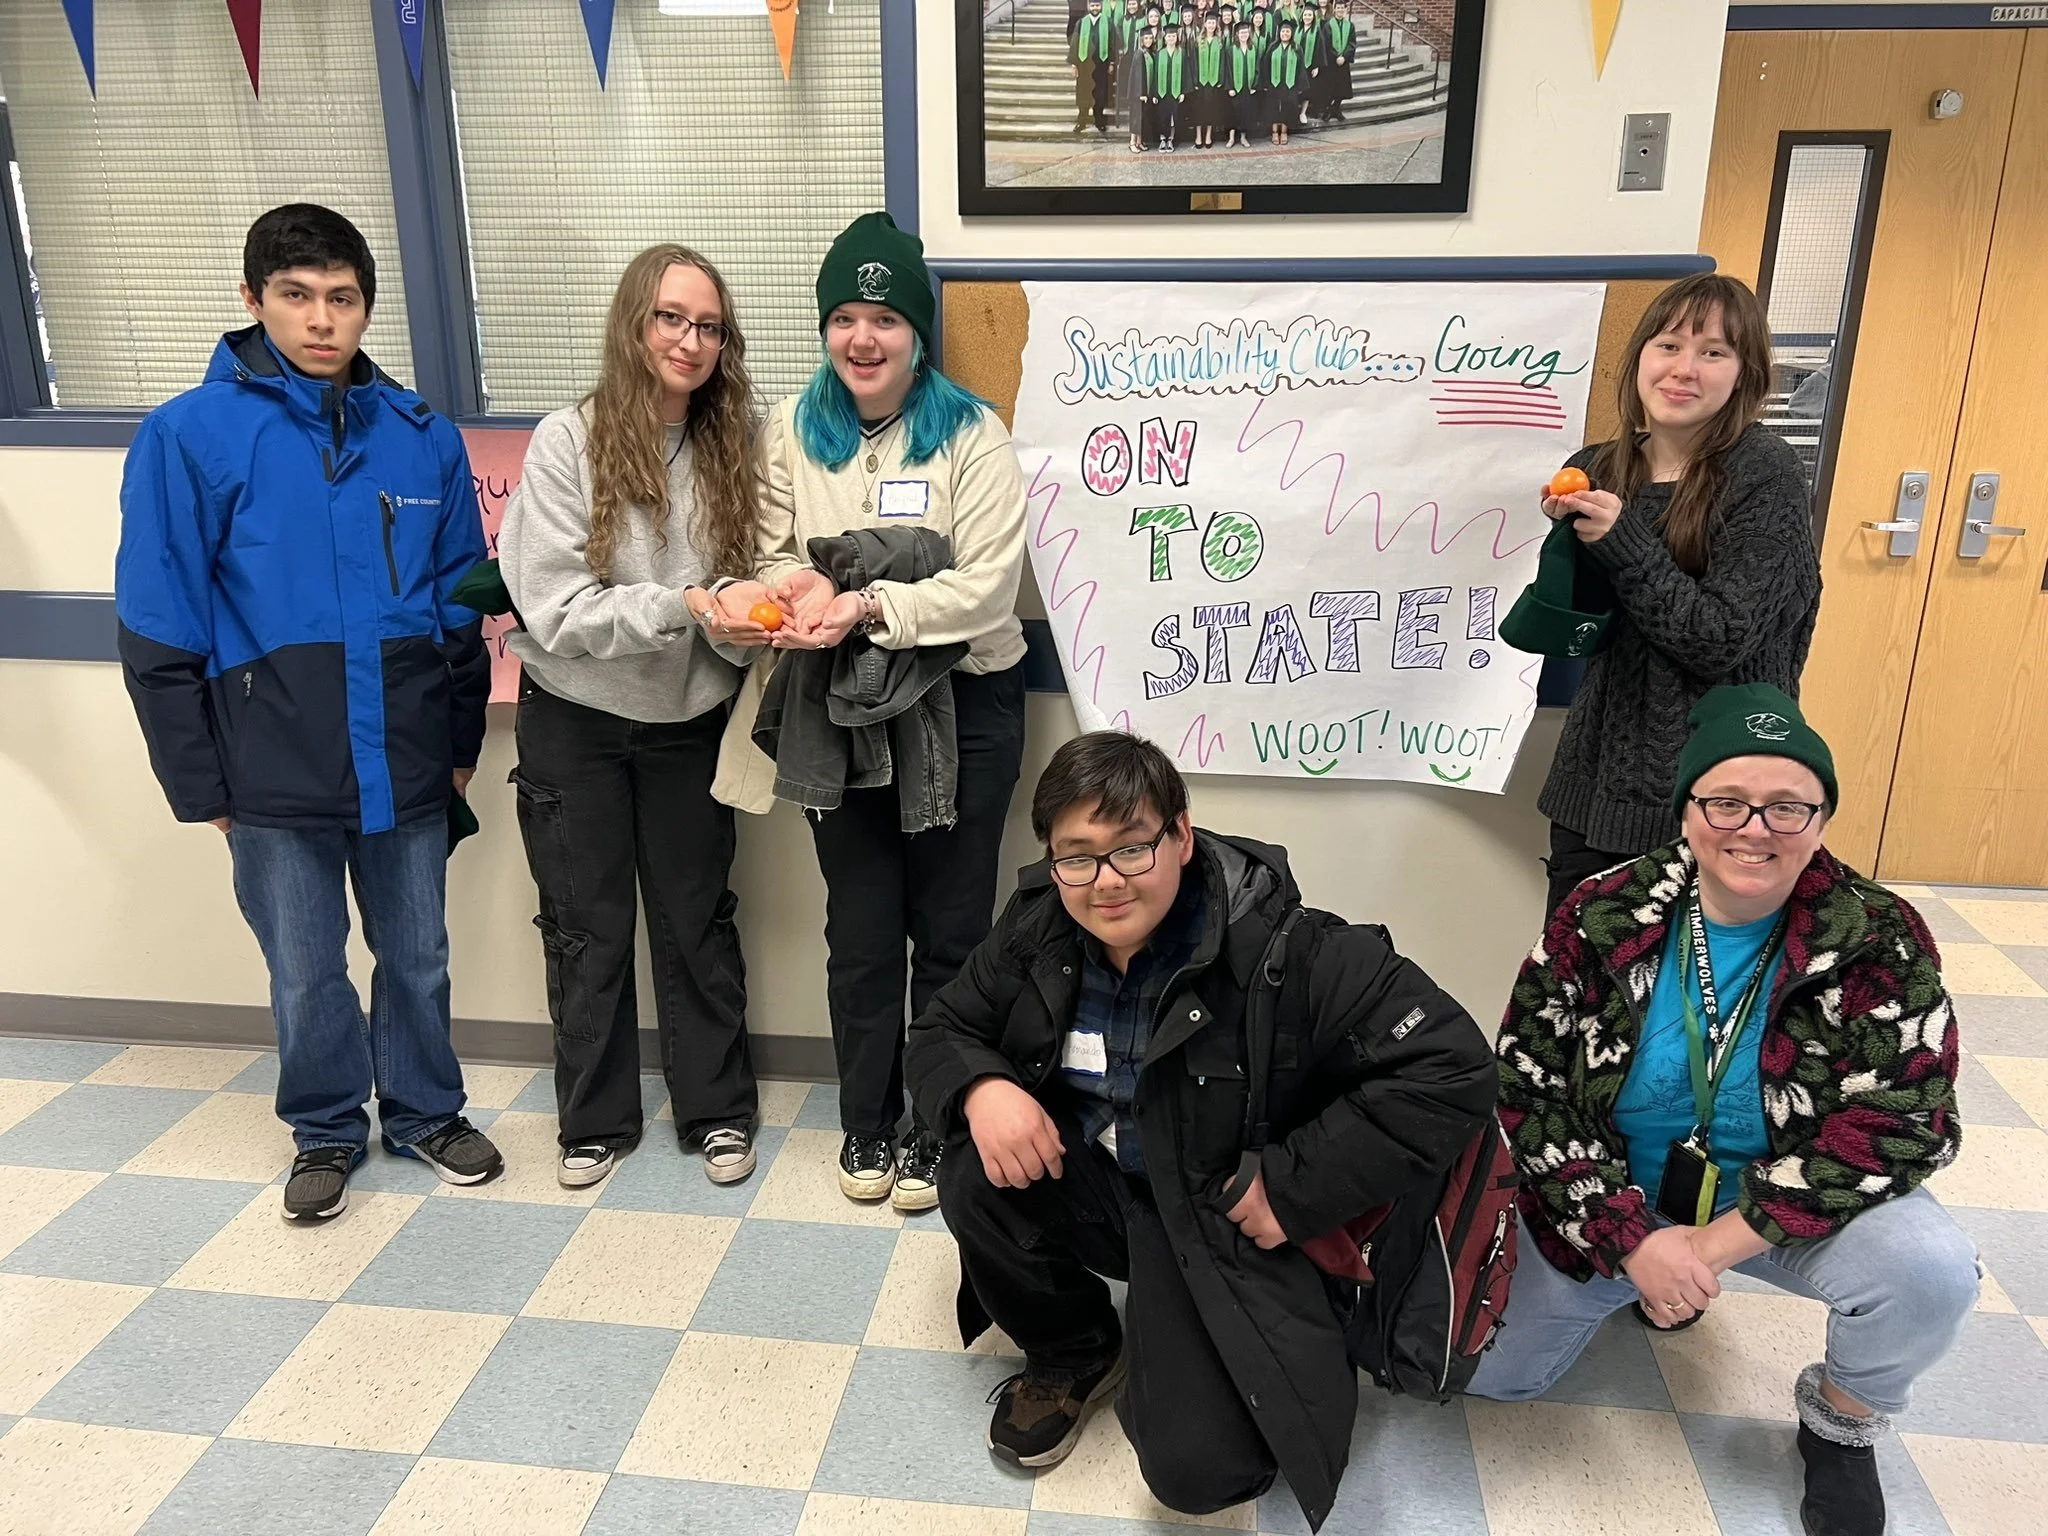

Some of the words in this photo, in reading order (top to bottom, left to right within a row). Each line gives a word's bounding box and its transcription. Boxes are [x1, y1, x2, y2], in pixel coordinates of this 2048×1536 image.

[1993, 8, 2048, 19] CAPACIT
[1063, 329, 1281, 393] Sustainability
[1435, 315, 1589, 389] Going
[1081, 417, 1197, 496] ON
[1129, 504, 1264, 582] TO
[1143, 586, 1498, 700] STATE!
[1250, 709, 1391, 763] WOOT!
[1400, 713, 1512, 762] WOOT!
[1690, 903, 1717, 1015] TIMBERWOLVES
